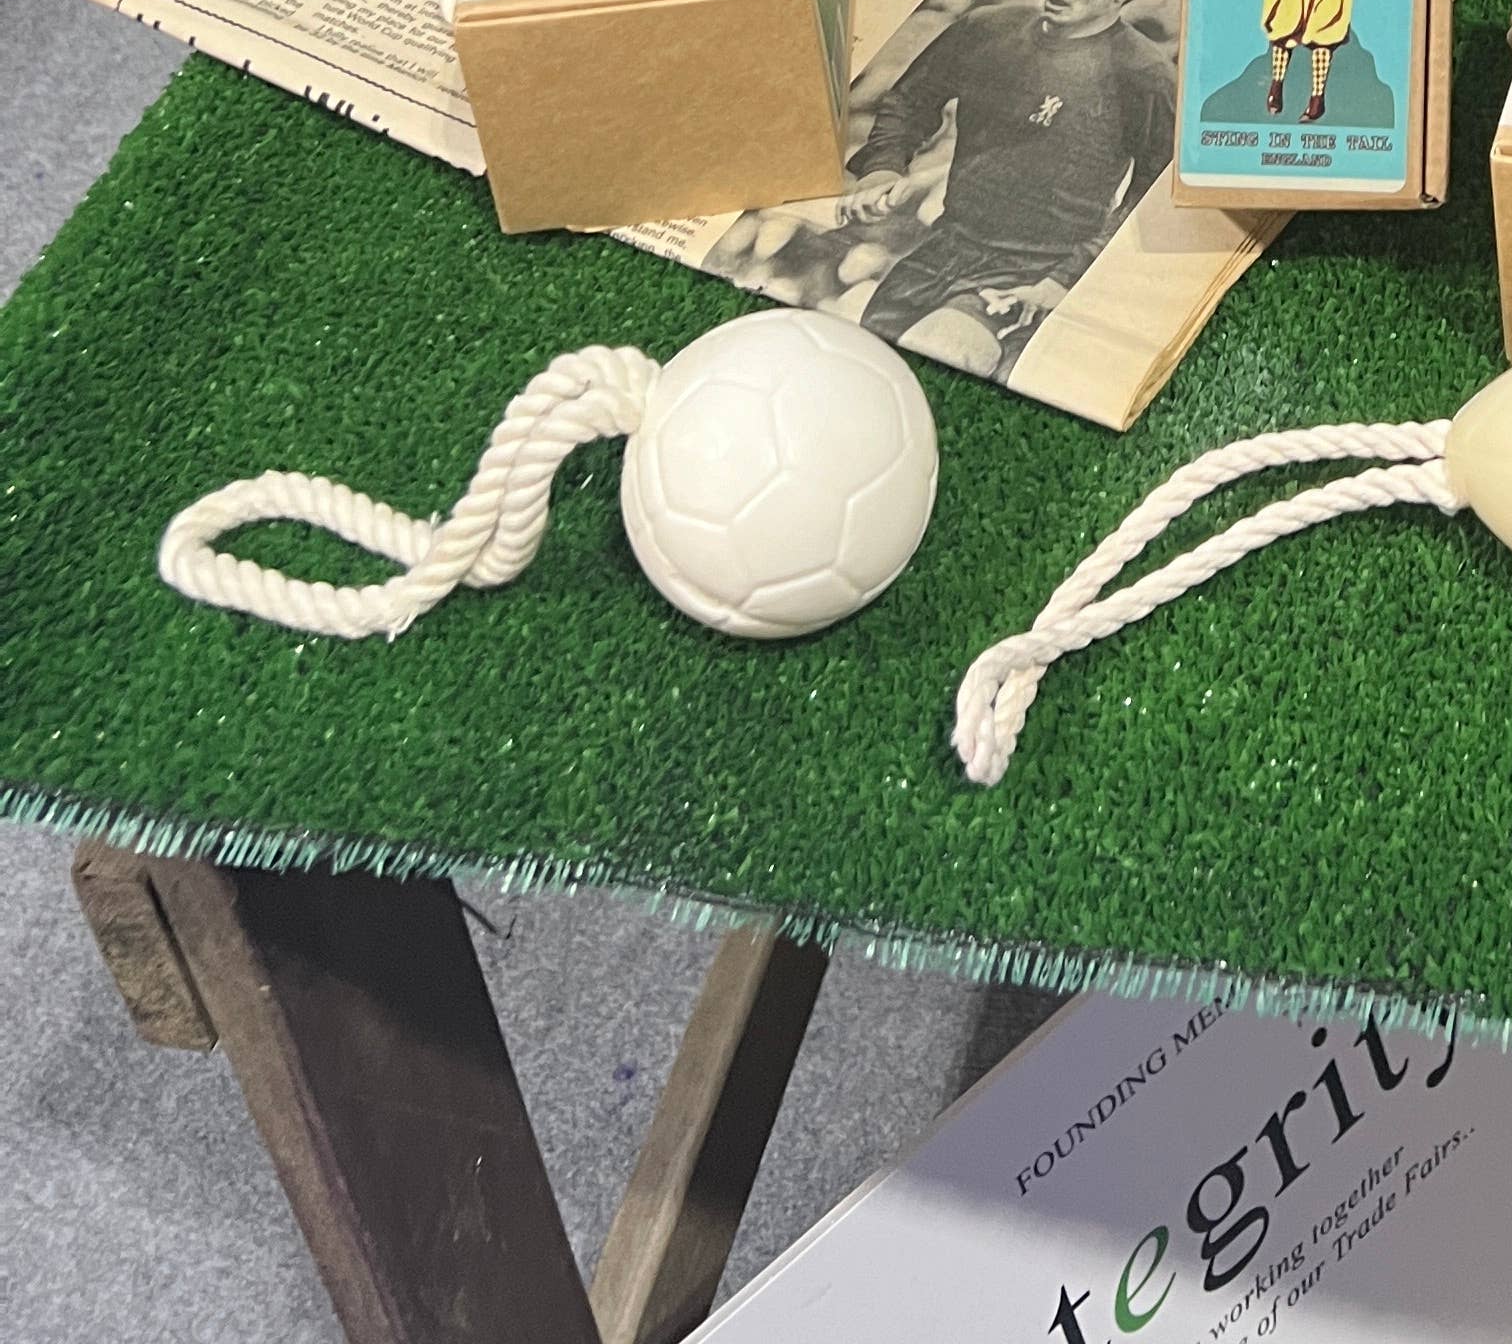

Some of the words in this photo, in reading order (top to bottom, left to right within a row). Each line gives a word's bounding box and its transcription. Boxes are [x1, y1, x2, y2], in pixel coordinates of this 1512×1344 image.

[1201, 129, 1259, 147] STING
[1269, 132, 1291, 147] IN
[1300, 134, 1337, 150] THE
[1346, 135, 1393, 151] TAIL
[1260, 152, 1332, 168] ENGLAND
[1016, 1047, 1168, 1198] FOUNDING
[1208, 1242, 1304, 1340] working
[1311, 1146, 1407, 1245] together
[1256, 1297, 1281, 1337] of
[1286, 1262, 1326, 1308] our
[1332, 1194, 1398, 1262] Trade
